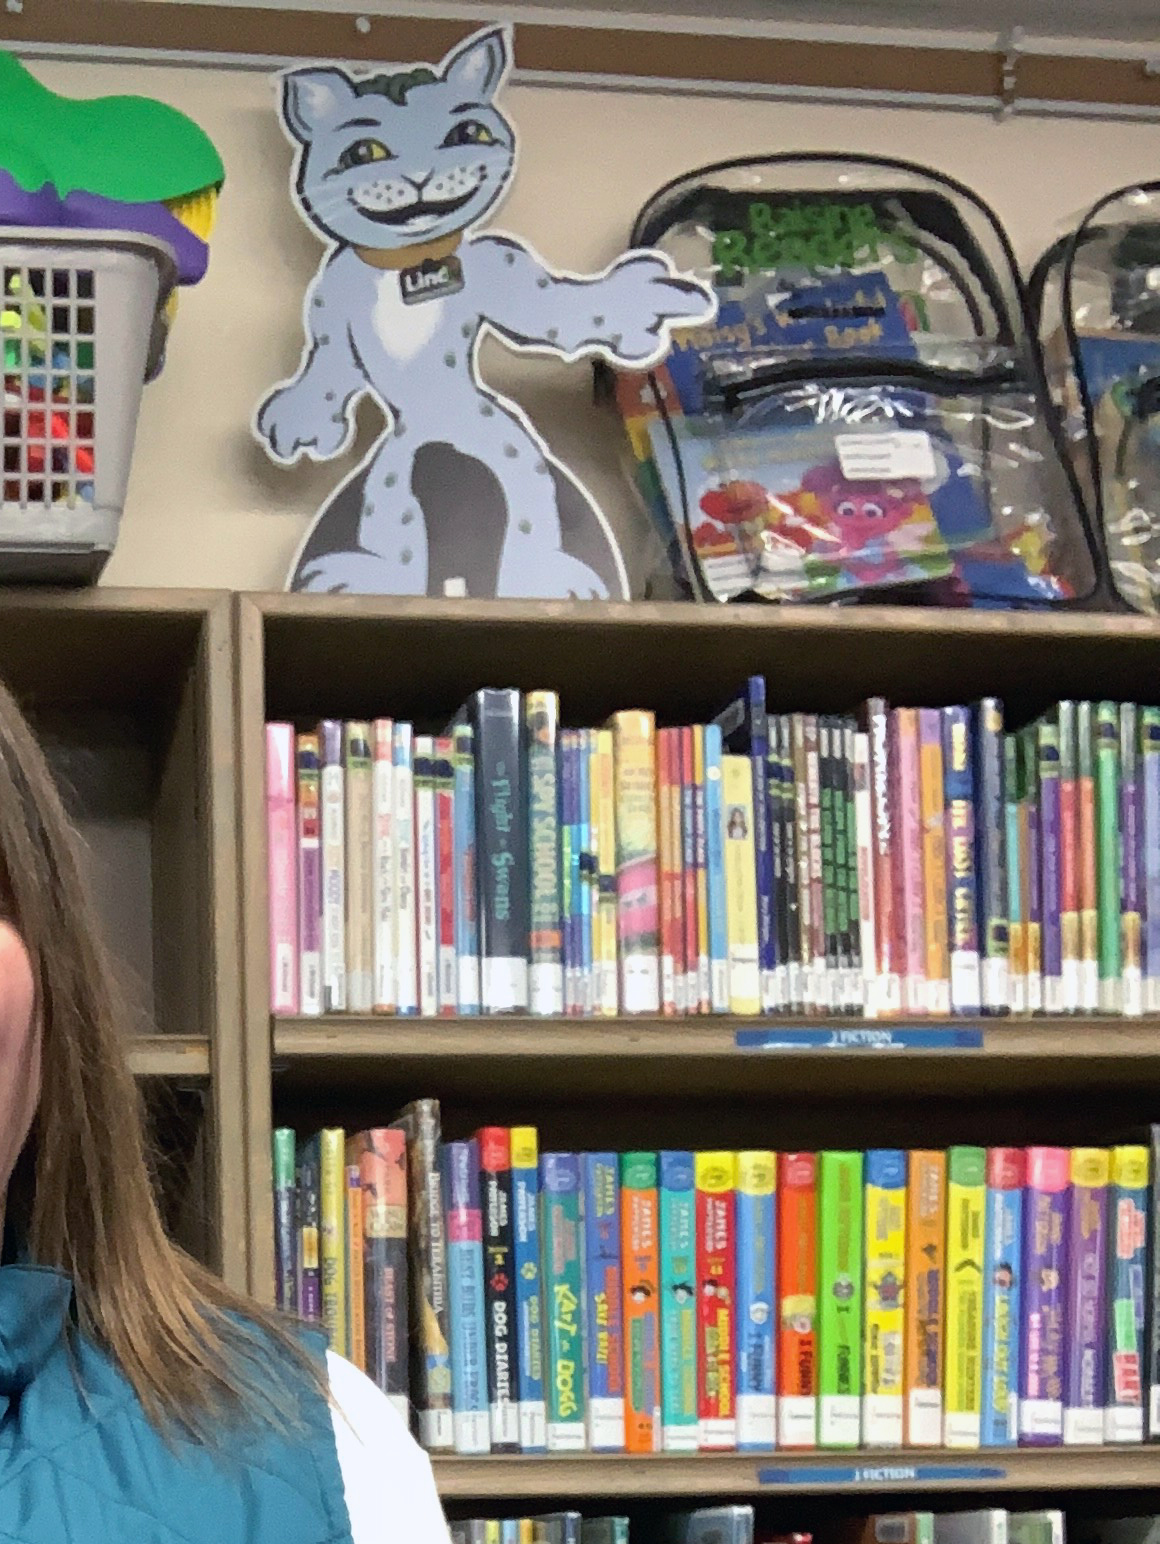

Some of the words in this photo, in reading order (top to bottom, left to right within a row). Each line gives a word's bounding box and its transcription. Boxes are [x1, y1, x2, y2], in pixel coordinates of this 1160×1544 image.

[531, 816, 557, 899] SCHOOL
[489, 851, 517, 921] Swans
[840, 1029, 892, 1045] FICTION
[499, 1190, 511, 1227] JAMES
[605, 1165, 617, 1215] JAMES
[640, 1198, 653, 1249] JAMES
[678, 1200, 692, 1249] JAMES
[714, 1199, 728, 1250] JAMES
[324, 1256, 339, 1286] DOG
[382, 1266, 397, 1304] BEAST
[494, 1300, 510, 1338] DOG
[383, 1322, 398, 1363] STONE
[554, 1357, 578, 1417] DOGG
[863, 1466, 916, 1480] FICTION
